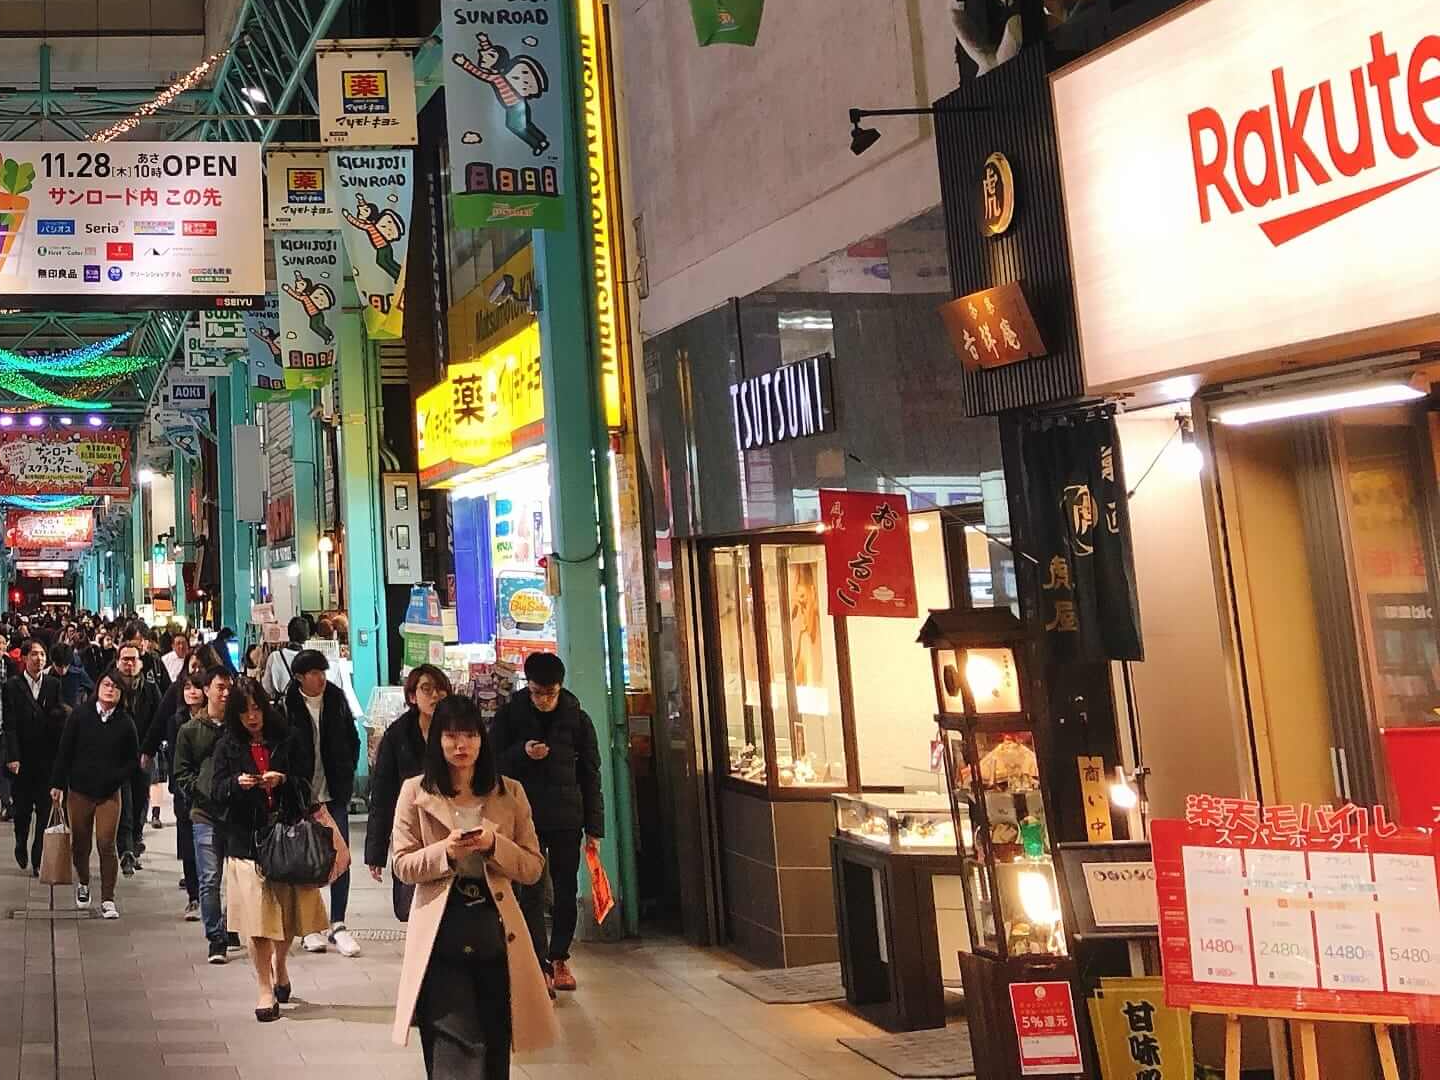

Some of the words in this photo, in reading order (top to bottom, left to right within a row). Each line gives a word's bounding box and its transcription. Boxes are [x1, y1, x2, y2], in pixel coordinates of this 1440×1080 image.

[454, 8, 549, 25] SUNROAD
[351, 74, 379, 96] 薬
[41, 152, 110, 178] 11.28
[137, 153, 159, 164] あさ
[162, 155, 237, 177] OPEN
[337, 155, 406, 170] KICHIJOJI
[135, 164, 161, 178] 10時
[293, 171, 317, 190] 薬
[339, 174, 406, 188] SUNROAD
[48, 188, 158, 206] サンロード内
[166, 188, 222, 207] この先
[85, 222, 119, 234] Seria
[280, 239, 337, 252] KICHIJOJI
[282, 253, 337, 266] SUNROAD
[38, 269, 78, 279] 無印良品
[223, 298, 253, 307] SEIYU
[452, 372, 484, 425] 薬
[729, 357, 824, 449] TSUTSUMI
[1186, 793, 1398, 839] 楽天モバイル
[1215, 827, 1369, 851] スーパーホーダイ
